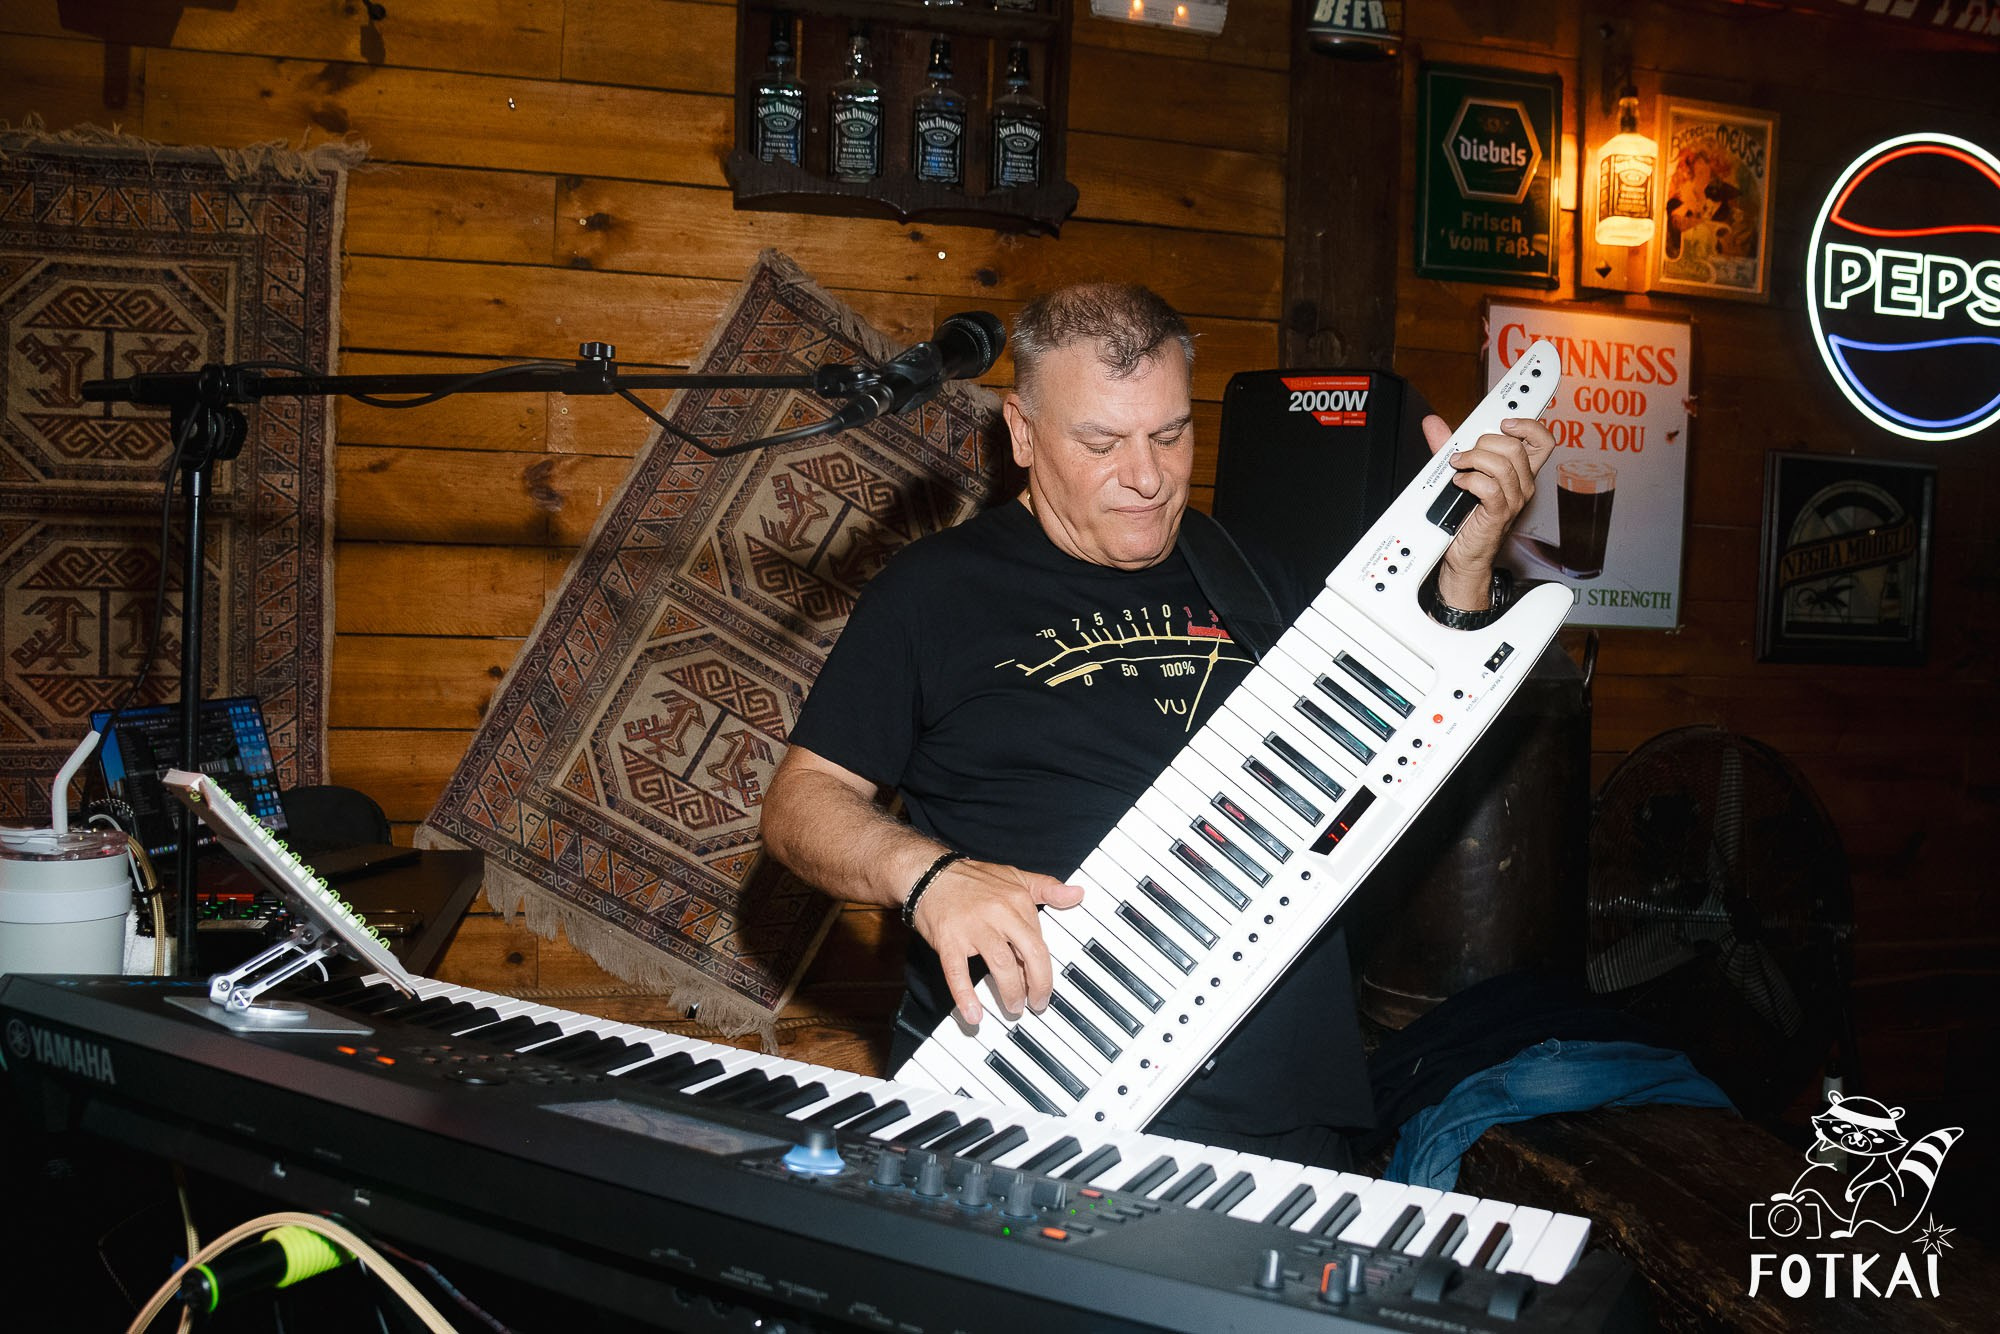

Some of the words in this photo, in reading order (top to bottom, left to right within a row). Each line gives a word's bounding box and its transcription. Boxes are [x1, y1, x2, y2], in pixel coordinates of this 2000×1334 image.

[1313, 0, 1386, 29] BEER
[758, 105, 775, 118] JACK
[836, 111, 851, 124] JACK
[919, 120, 935, 133] JACK
[1000, 126, 1015, 138] JACK
[1462, 211, 1522, 234] Frisch
[1449, 233, 1489, 253] vom
[1497, 323, 1678, 386] GINNESS
[1288, 390, 1369, 412] 2000W
[1574, 386, 1647, 417] GOOD
[1592, 422, 1646, 453] YOU
[1588, 588, 1672, 609] STRENGTH
[1072, 618, 1080, 631] 7
[1093, 612, 1104, 626] 5
[1123, 609, 1133, 621] 3
[1141, 607, 1149, 620] 1
[1162, 604, 1171, 618] 0
[1084, 675, 1093, 687] 0
[1121, 664, 1138, 677] 50
[1160, 661, 1195, 678] 100%
[1154, 698, 1187, 715] VU
[31, 1026, 115, 1084] YAMAHA
